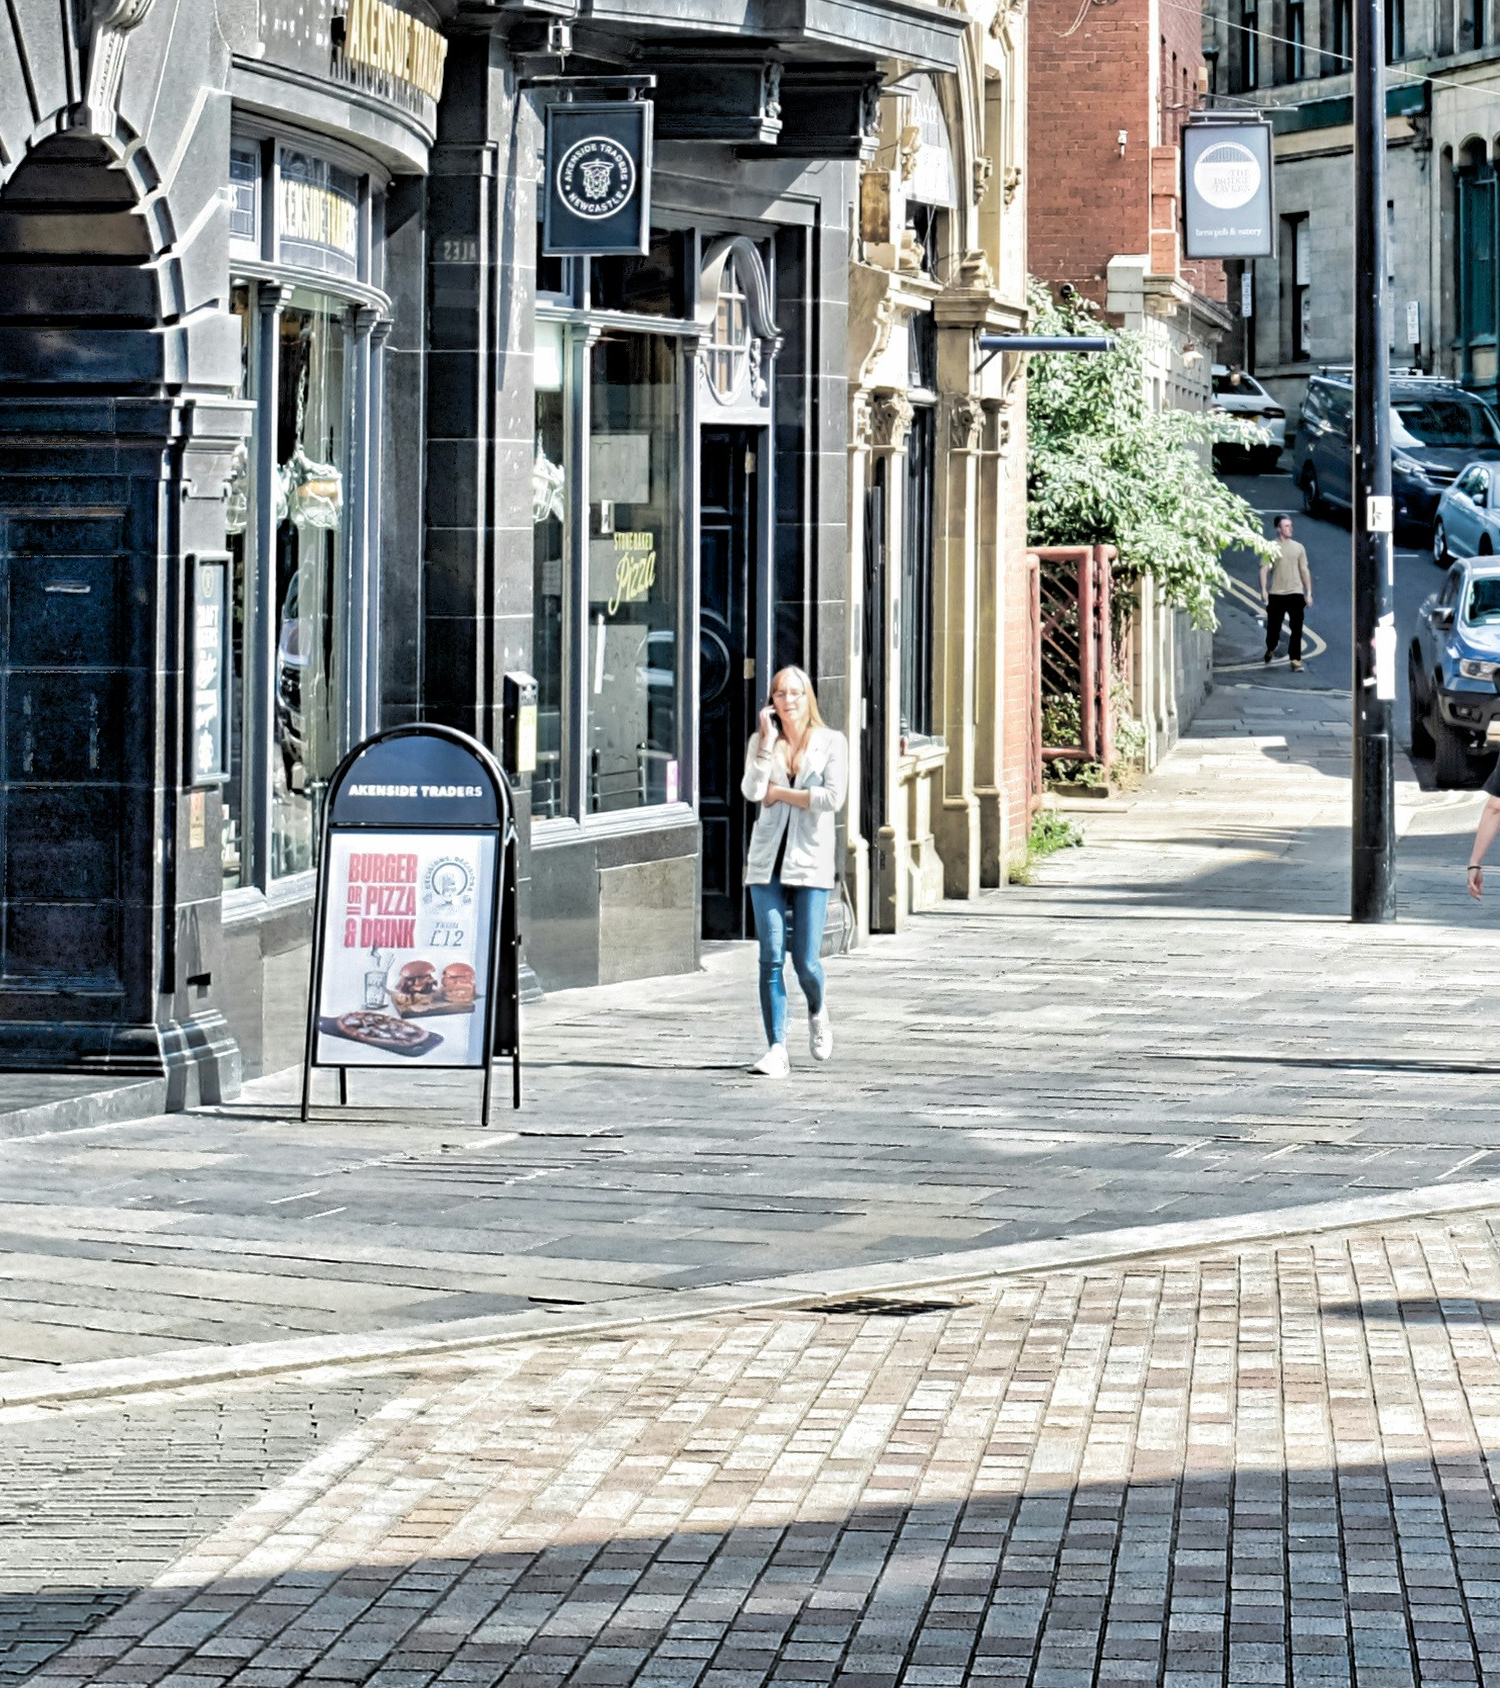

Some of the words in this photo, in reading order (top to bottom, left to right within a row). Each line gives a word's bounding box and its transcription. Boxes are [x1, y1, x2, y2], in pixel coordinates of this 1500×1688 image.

[564, 143, 597, 183] AKENSIDE
[600, 143, 628, 181] TRADERS
[568, 191, 625, 213] NEWCASTLE
[608, 551, 657, 616] Pizza
[349, 784, 418, 797] AKENSIDE
[421, 785, 483, 798] TRADERS
[348, 853, 419, 884] BURGER
[347, 885, 362, 904] OR
[365, 885, 417, 916] PIZZA
[344, 918, 357, 948] &
[360, 918, 416, 949] DRINK
[429, 929, 465, 947] £12
